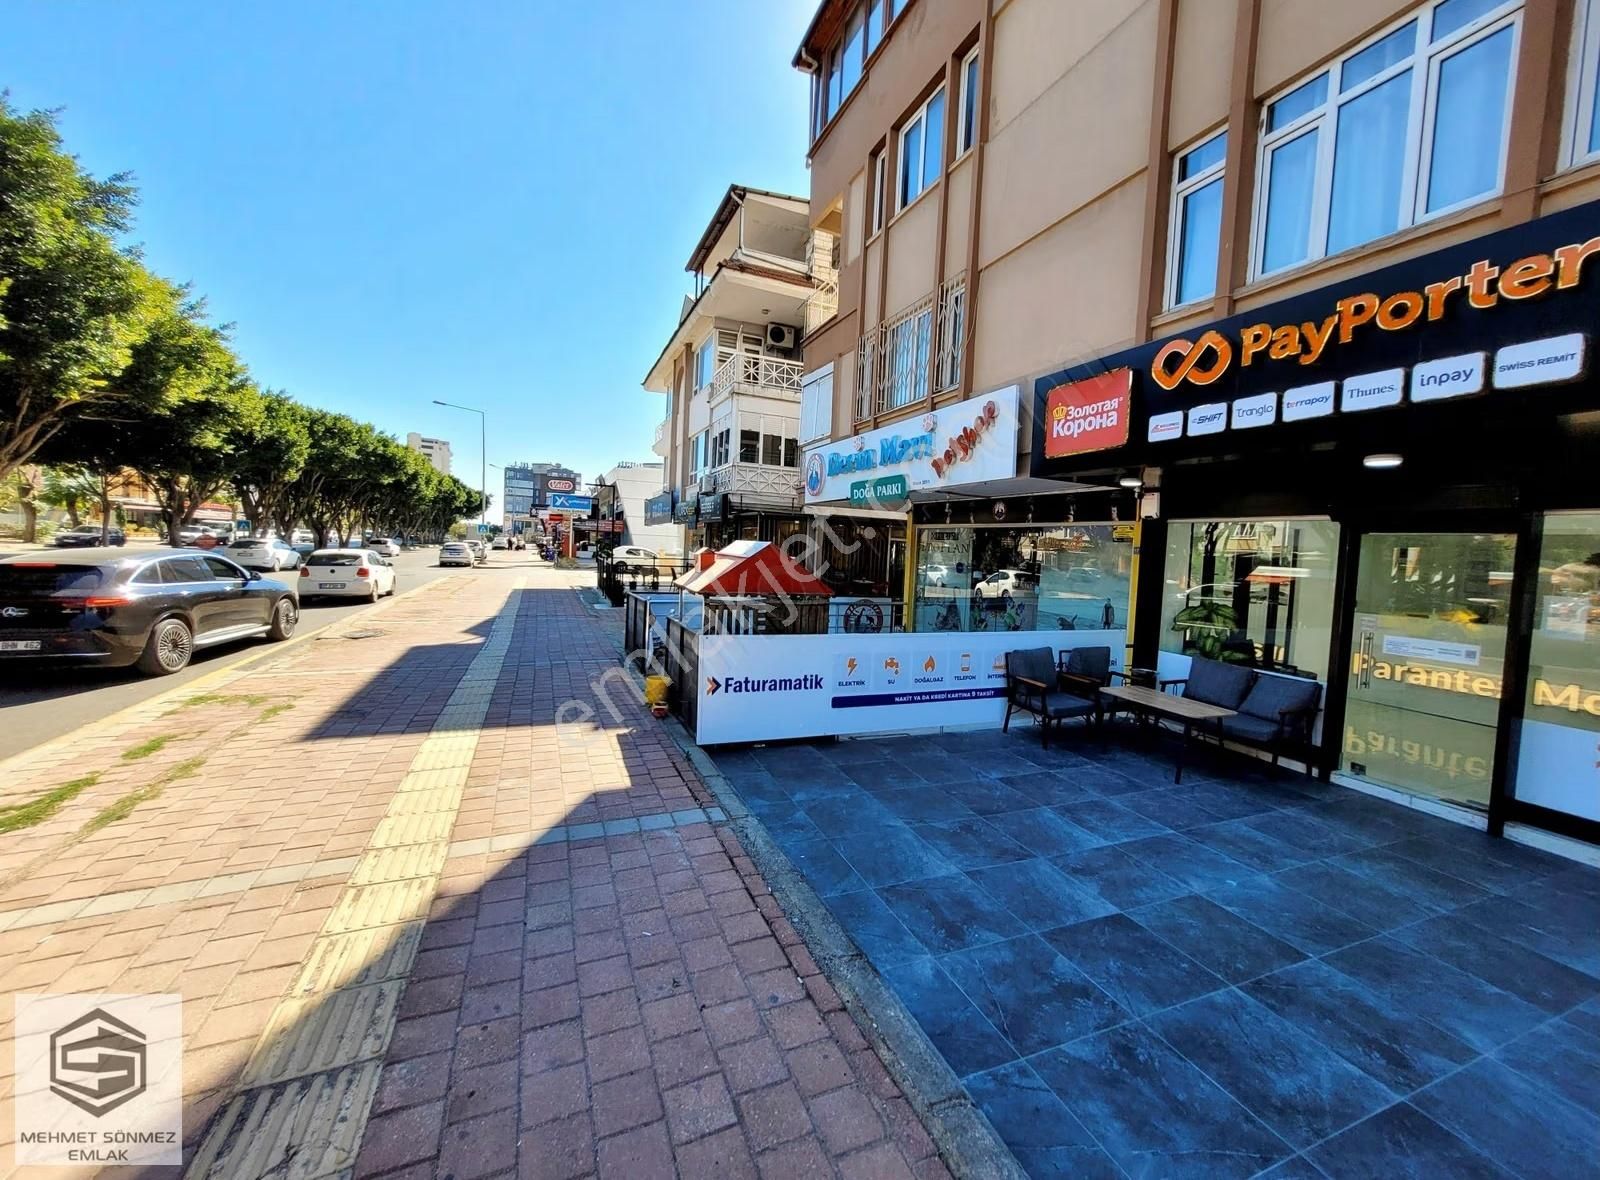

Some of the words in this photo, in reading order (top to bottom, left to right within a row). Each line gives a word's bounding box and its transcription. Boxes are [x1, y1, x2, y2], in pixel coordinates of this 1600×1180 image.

[1240, 237, 1600, 367] PayPorter
[1420, 367, 1474, 387] inpay
[1196, 412, 1224, 425] SHIFT
[1236, 404, 1273, 419] Tranglo
[1052, 411, 1118, 438] Корона
[853, 482, 876, 499] DOĞA
[724, 674, 824, 694] Faturamatik
[1351, 652, 1503, 699] Parante
